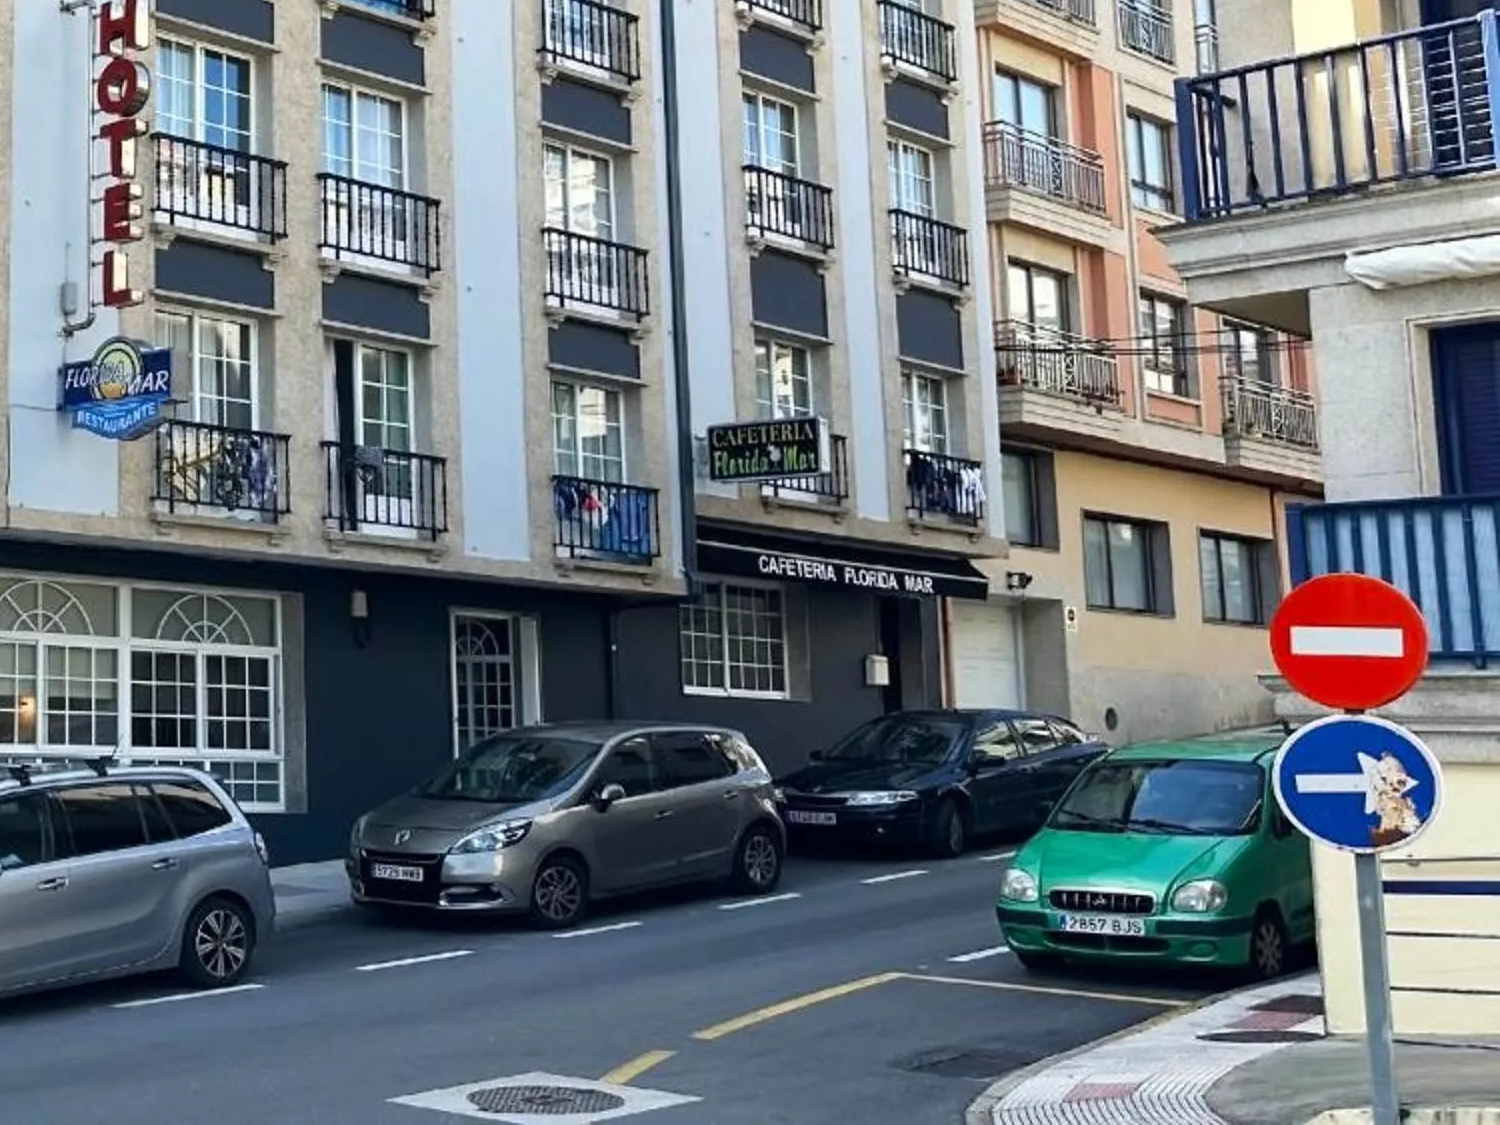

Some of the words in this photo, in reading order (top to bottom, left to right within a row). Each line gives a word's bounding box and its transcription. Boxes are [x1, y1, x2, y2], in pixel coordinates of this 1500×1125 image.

[127, 371, 169, 395] MAR
[77, 403, 156, 432] RESTAURANTE
[712, 422, 814, 448] CAFETERIA
[714, 448, 769, 475] Florida
[783, 444, 817, 471] Mar
[759, 555, 837, 582] CAFETERIA
[844, 567, 899, 590] FLORIDA
[904, 575, 934, 593] MAR
[1069, 916, 1107, 932] 2857
[1111, 918, 1142, 934] BJS
